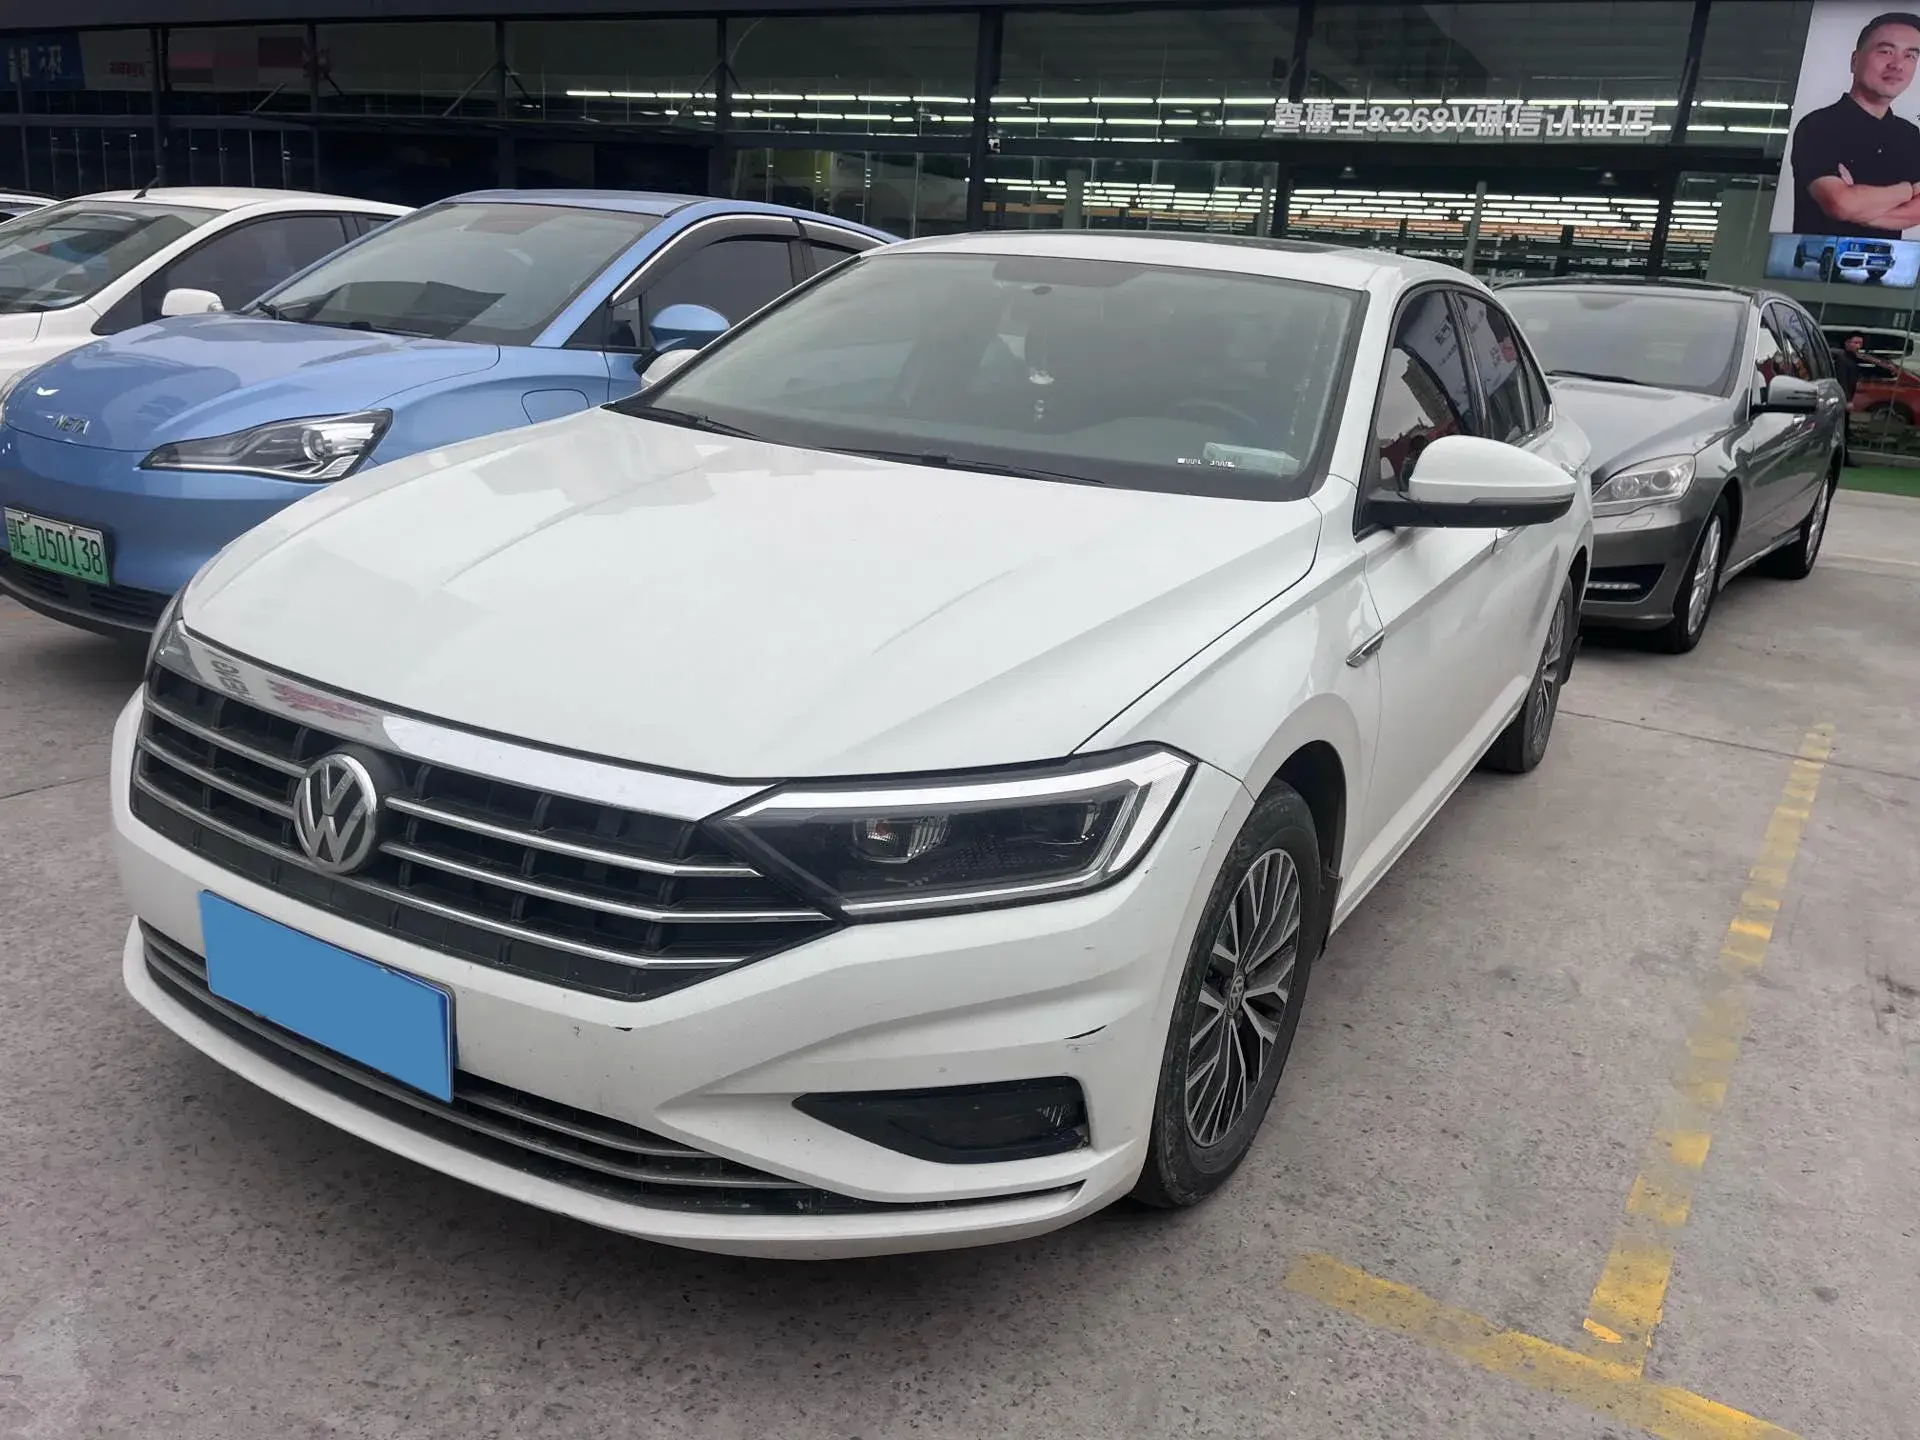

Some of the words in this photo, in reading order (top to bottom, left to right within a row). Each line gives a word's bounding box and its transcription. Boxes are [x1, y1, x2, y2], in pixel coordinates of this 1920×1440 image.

[1273, 102, 1656, 137] 查博士&268V诚信认证店
